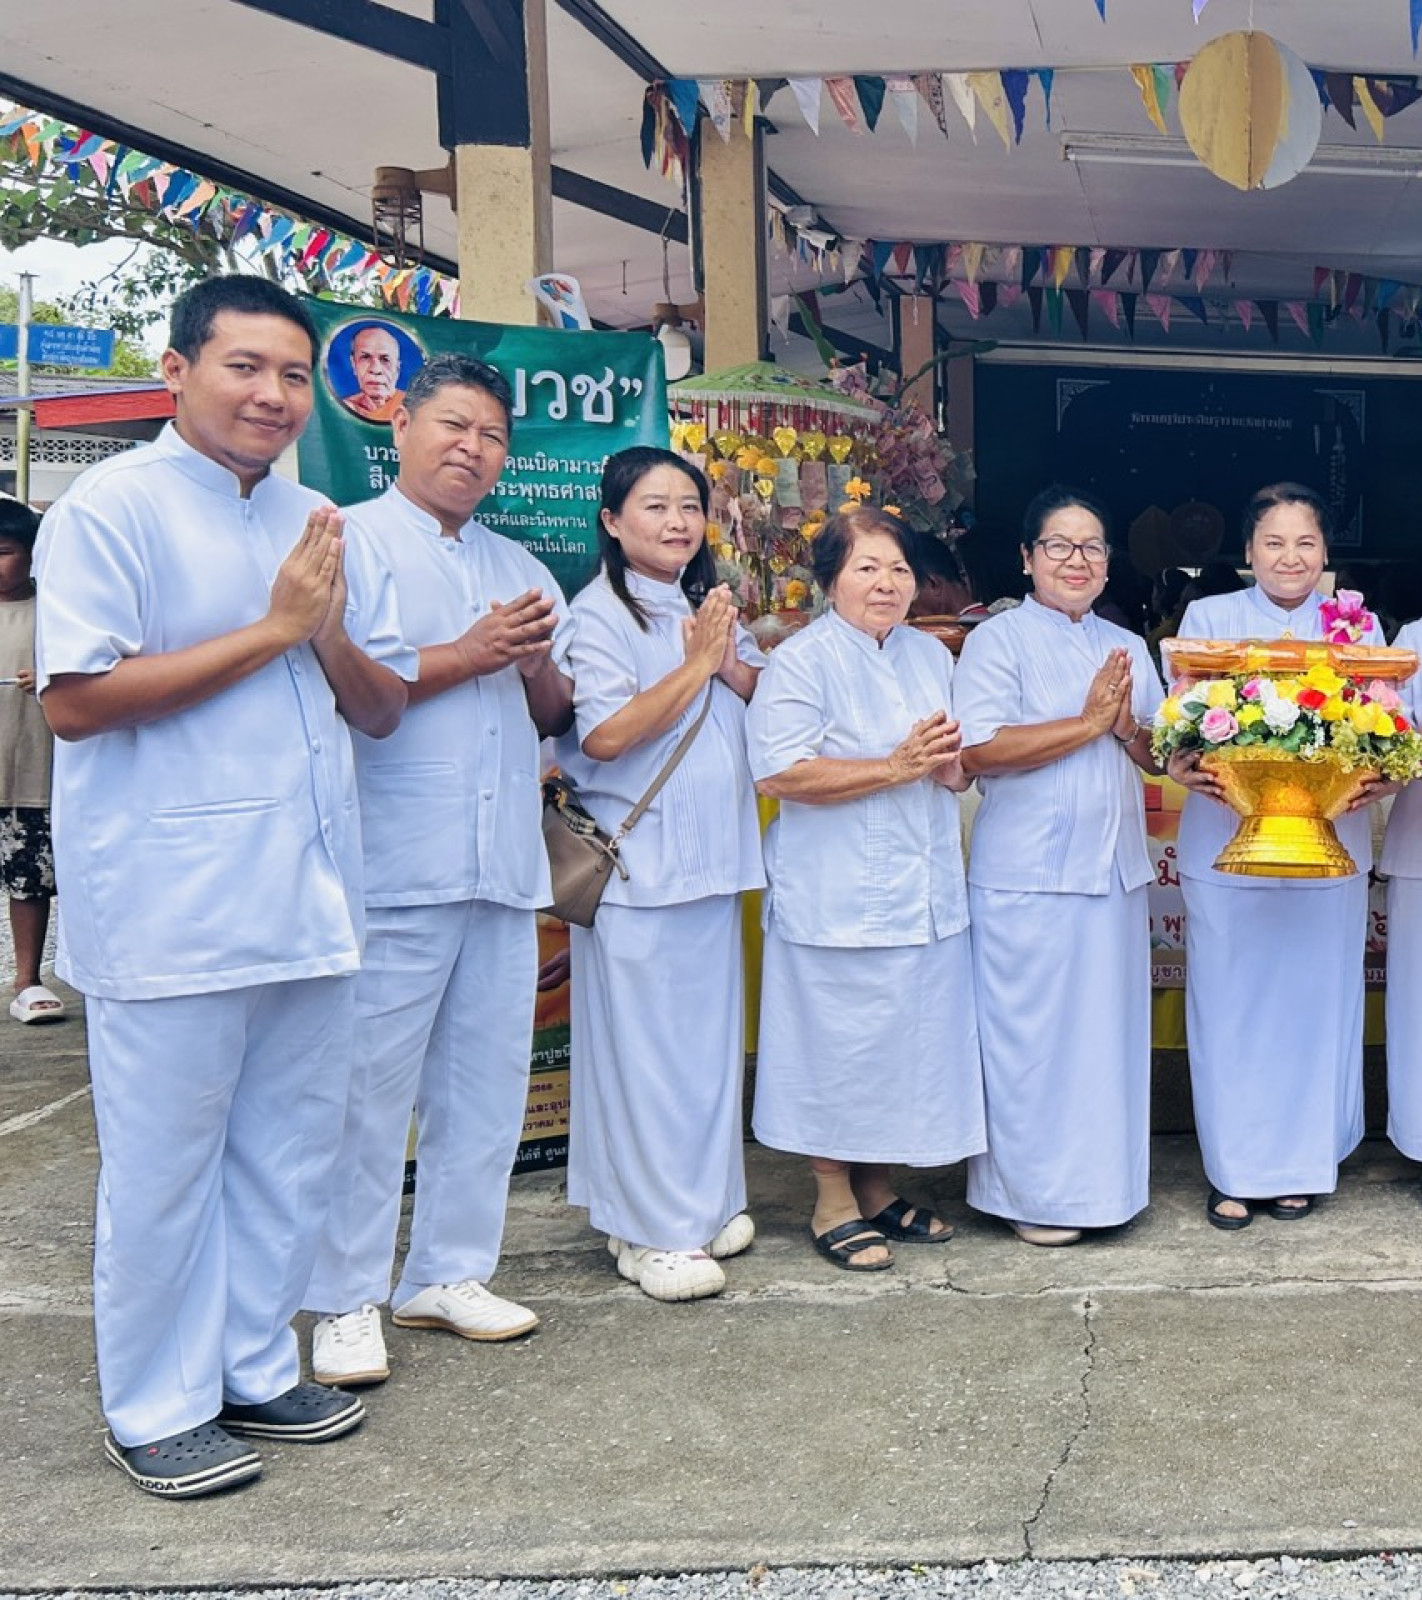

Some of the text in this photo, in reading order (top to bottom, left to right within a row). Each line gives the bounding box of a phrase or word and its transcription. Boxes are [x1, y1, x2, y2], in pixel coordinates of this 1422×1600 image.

[504, 451, 607, 476] คุณบิดามาร
[471, 508, 587, 528] วรรค์และนิพพาน
[521, 533, 586, 554] คนในโลก
